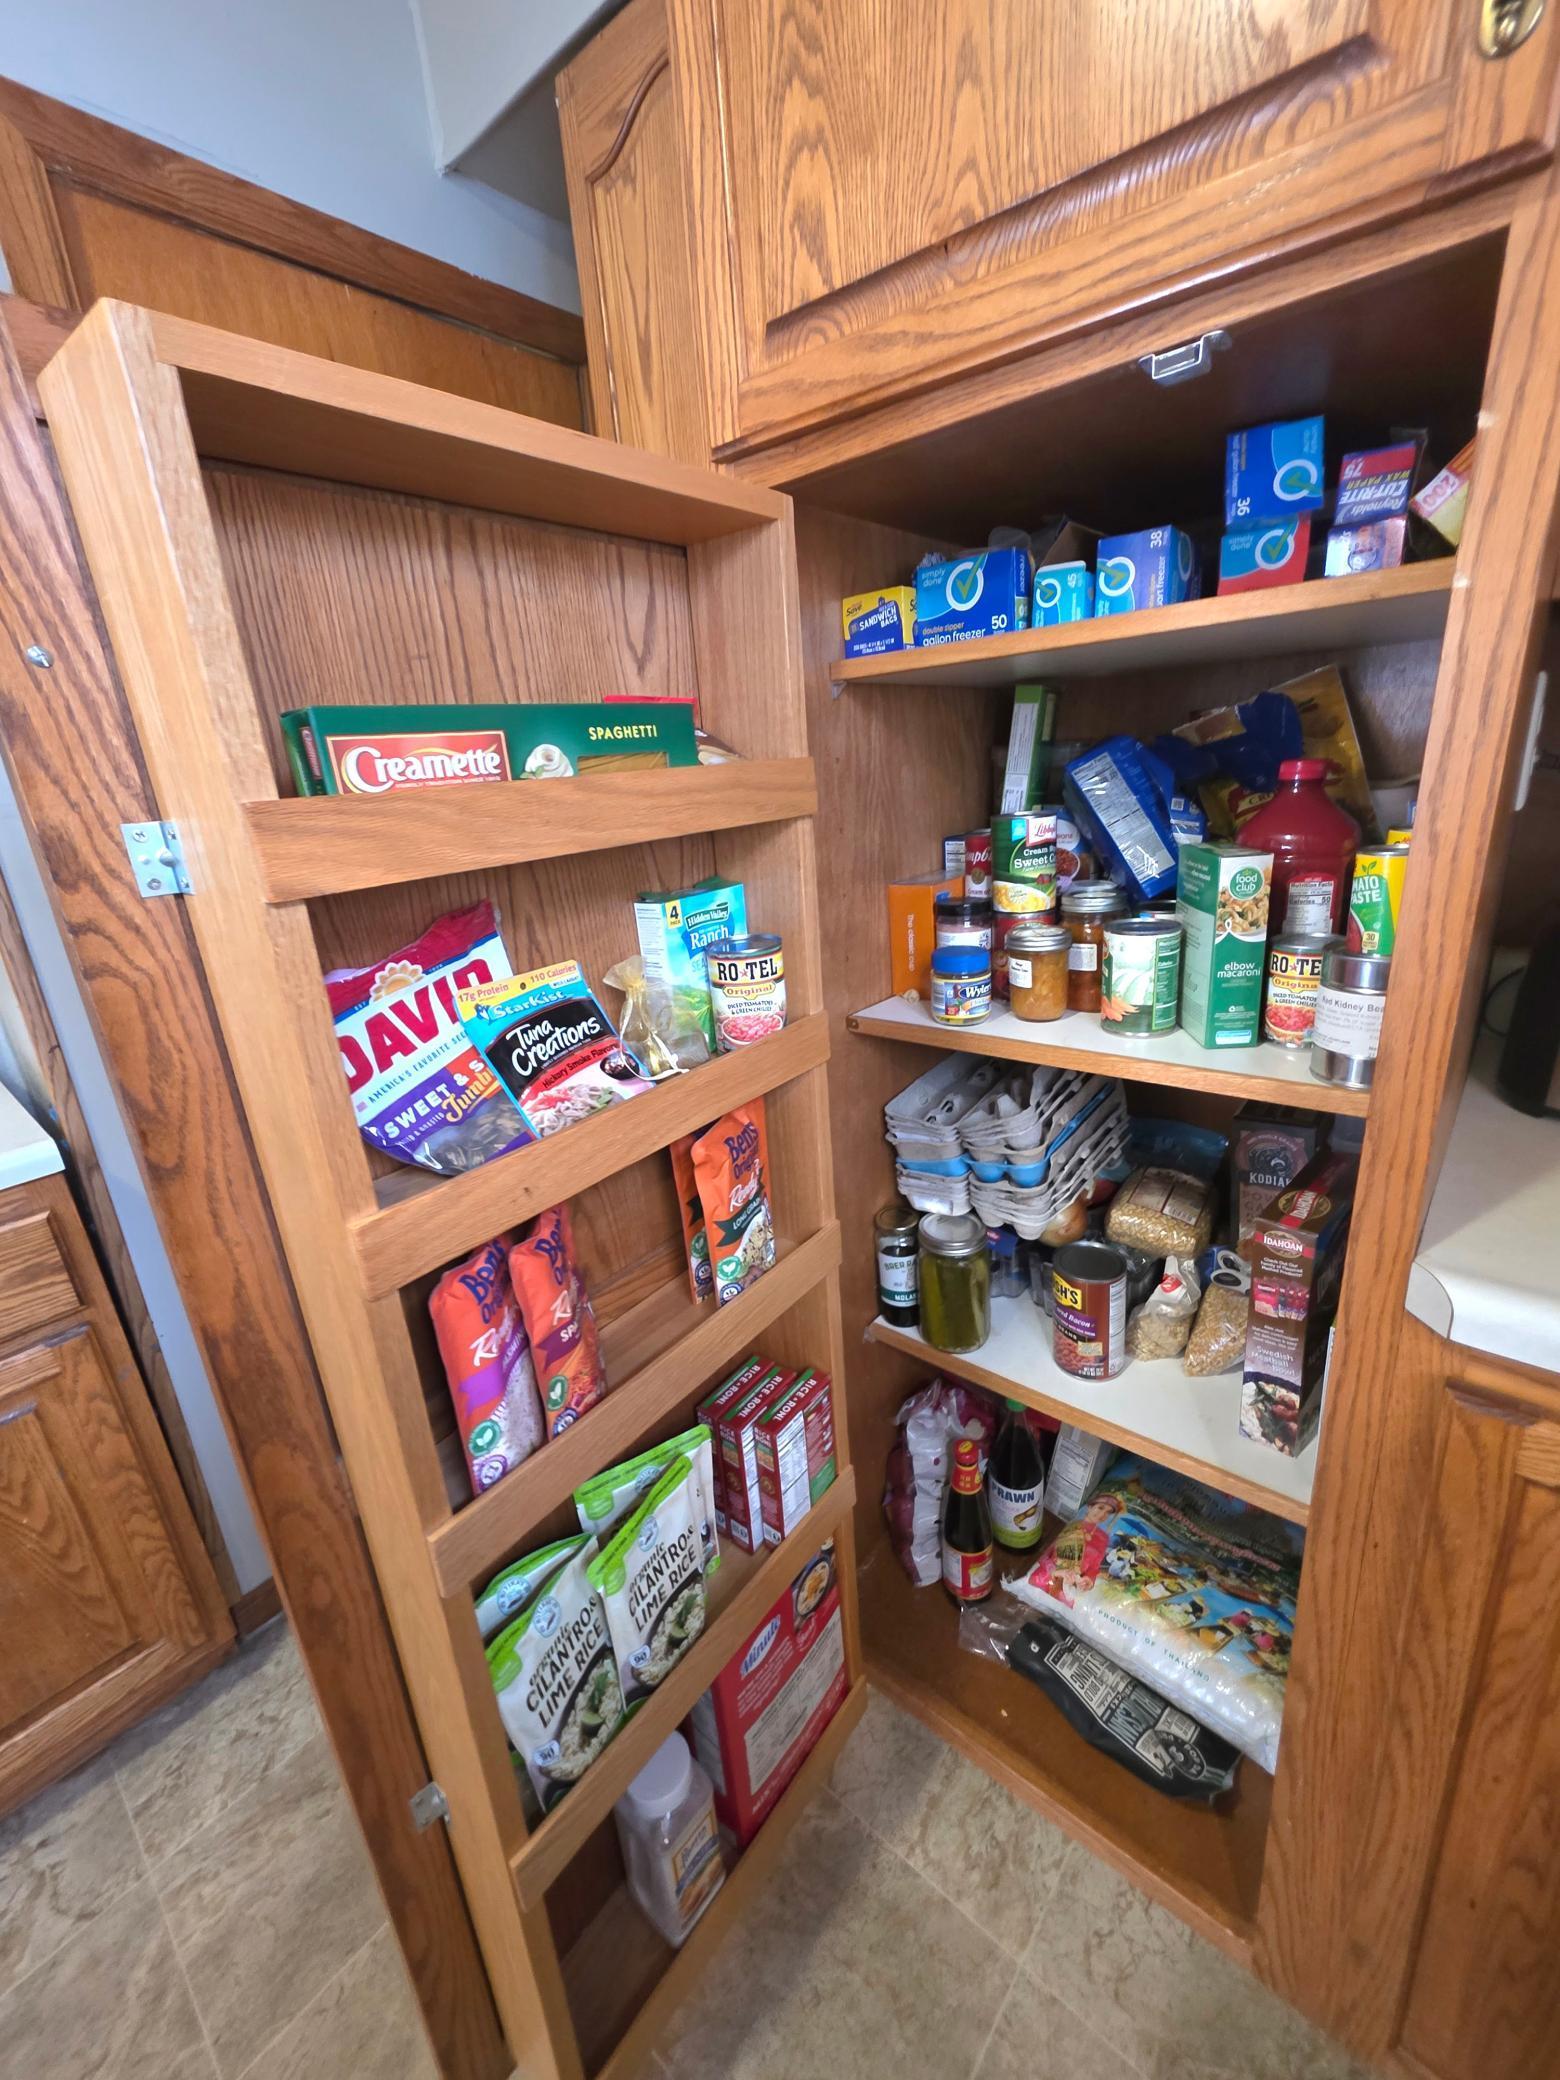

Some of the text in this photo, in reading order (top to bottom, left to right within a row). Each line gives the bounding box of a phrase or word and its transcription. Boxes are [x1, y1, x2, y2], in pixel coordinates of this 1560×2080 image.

[1344, 461, 1364, 479] 75
[1347, 469, 1410, 491] WAX PAPER
[1236, 496, 1250, 516] 36
[1351, 497, 1404, 515] Reynolds
[1151, 530, 1163, 548] 38
[921, 568, 947, 581] simply
[922, 577, 943, 588] done
[1067, 573, 1077, 589] 45
[859, 605, 897, 631] SANDWICH
[880, 615, 898, 629] BAGS
[991, 613, 1008, 630] 50
[922, 627, 986, 647] gallon freezer
[588, 724, 658, 741] SPAGHETTI
[346, 745, 501, 793] Creamette
[1023, 846, 1048, 857] Cream
[1014, 855, 1048, 869] Sweet
[1235, 873, 1258, 884] food
[1236, 882, 1257, 892] club
[669, 905, 680, 920] 4
[688, 908, 729, 927] Hidden Valley
[690, 924, 729, 950] Ranch
[907, 928, 915, 958] classic
[1365, 932, 1376, 942] 30
[1217, 968, 1262, 979] macaroni
[1224, 961, 1255, 972] elbow
[458, 964, 577, 1004] 17g Protein 110 Calories
[726, 984, 773, 997] Original
[1274, 977, 1318, 990] Origina
[491, 989, 564, 1020] StarKist
[1334, 1000, 1364, 1014] Kidney
[506, 1019, 554, 1050] Tuna
[511, 1015, 602, 1077] Creations
[368, 1069, 414, 1104] AMERICA'S
[413, 1042, 451, 1073] FAVORITE
[542, 1064, 568, 1089] Hickory
[567, 1054, 592, 1072] Smoke
[441, 1066, 495, 1123] Jumb
[384, 1082, 450, 1140] SWEET
[453, 1072, 470, 1087] &
[733, 1212, 747, 1230] LONG
[1263, 1235, 1303, 1252] IDAHOAN
[1068, 1313, 1091, 1329] Bacon
[1251, 1351, 1289, 1368] Meatball
[1256, 1345, 1294, 1362] Swedish
[715, 1364, 761, 1406] RICE RONI
[796, 1378, 817, 1399] RICE
[738, 1375, 784, 1419] RICE RONI
[773, 1400, 797, 1422] RONI
[754, 1427, 771, 1440] RICE
[627, 1533, 689, 1618] CILANTRO
[629, 1540, 666, 1594] organic
[635, 1544, 697, 1633] LIME RICE
[529, 1622, 571, 1687] organic
[1098, 1609, 1210, 1682] PRODUCT OF THAILAND
[526, 1606, 592, 1712] CILANTRO
[538, 1667, 576, 1729] LIME
[575, 1617, 605, 1673] RICE
